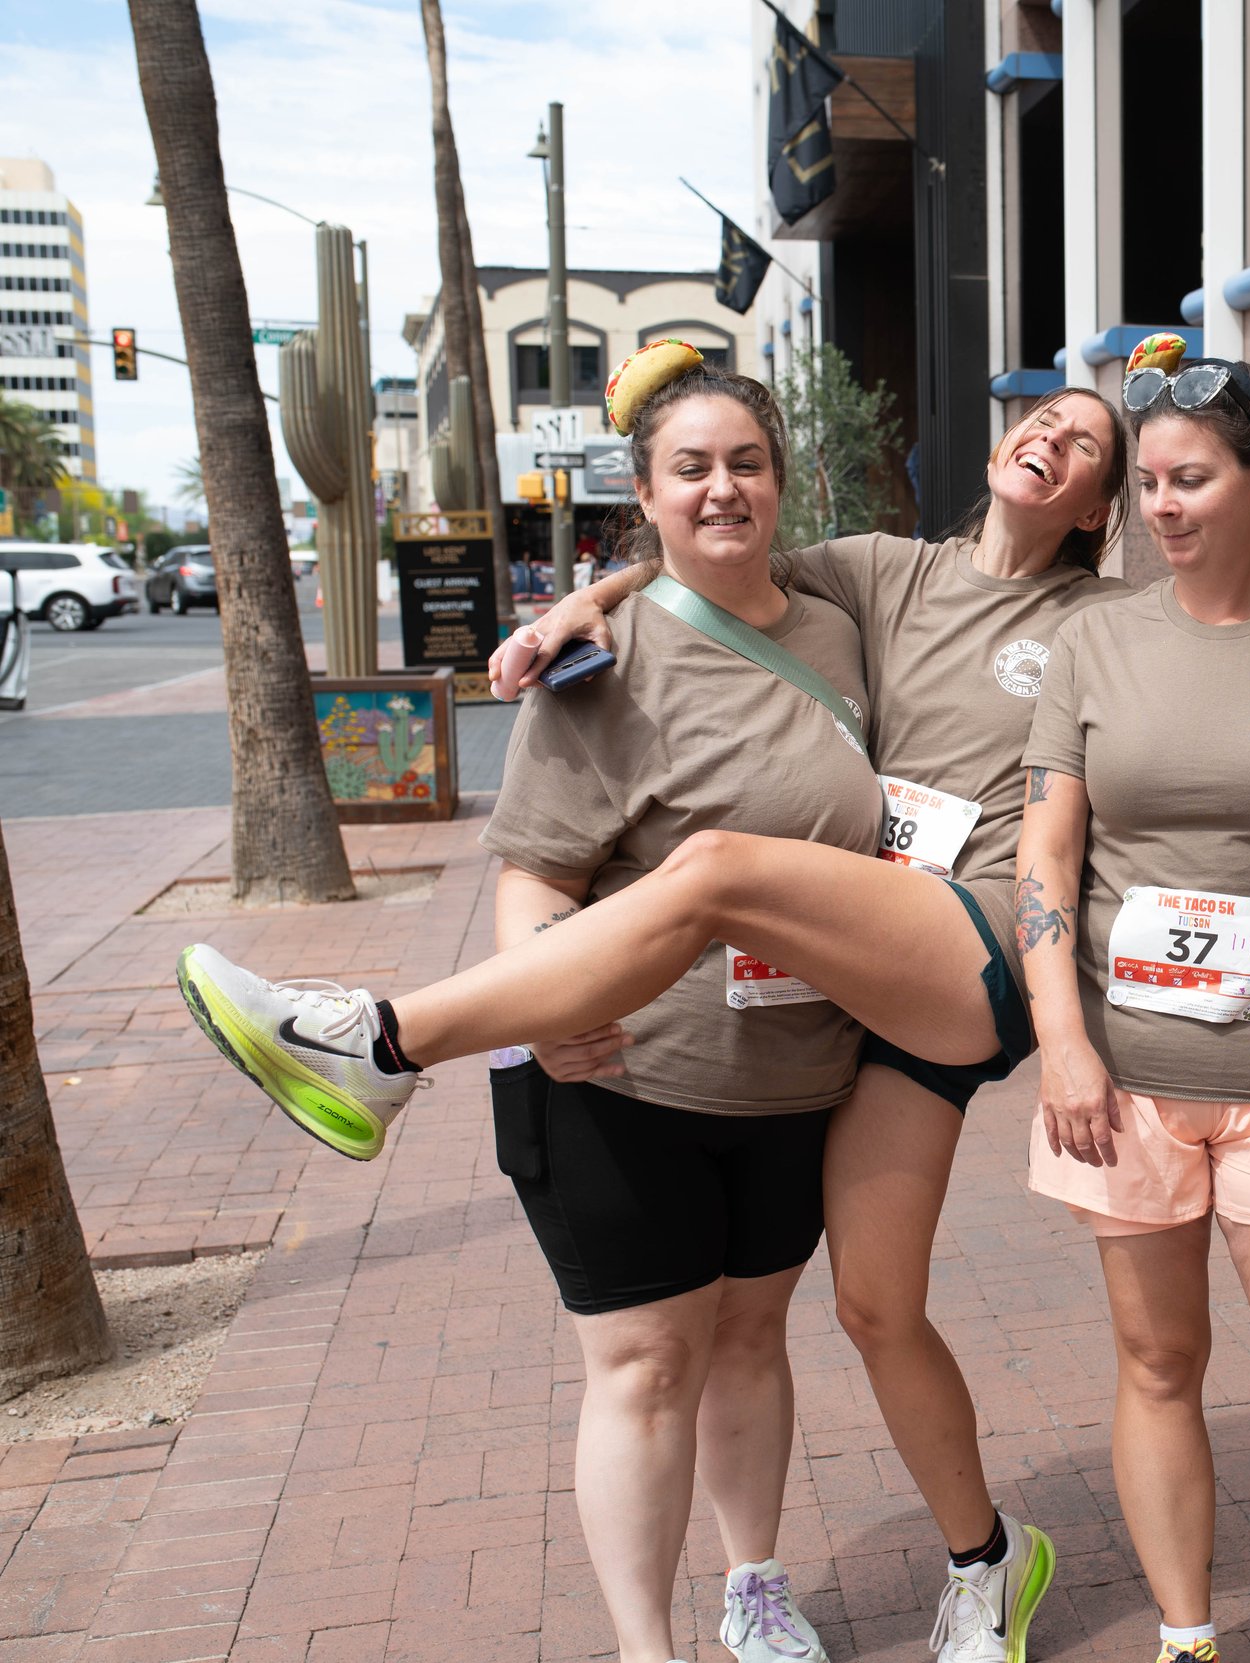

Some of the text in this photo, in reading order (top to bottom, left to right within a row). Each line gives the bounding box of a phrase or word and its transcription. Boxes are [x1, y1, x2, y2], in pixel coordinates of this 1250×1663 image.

[413, 577, 480, 589] GUEST ARRIVAL
[423, 601, 474, 612] DEPARTURE
[1002, 641, 1020, 656] THE
[1020, 641, 1043, 655] TACO
[887, 783, 945, 810] THE TACO 5K
[885, 815, 918, 851] 38
[1157, 893, 1236, 915] THE TACO 5K
[1178, 915, 1211, 929] TUCSON
[1165, 928, 1219, 965] 37
